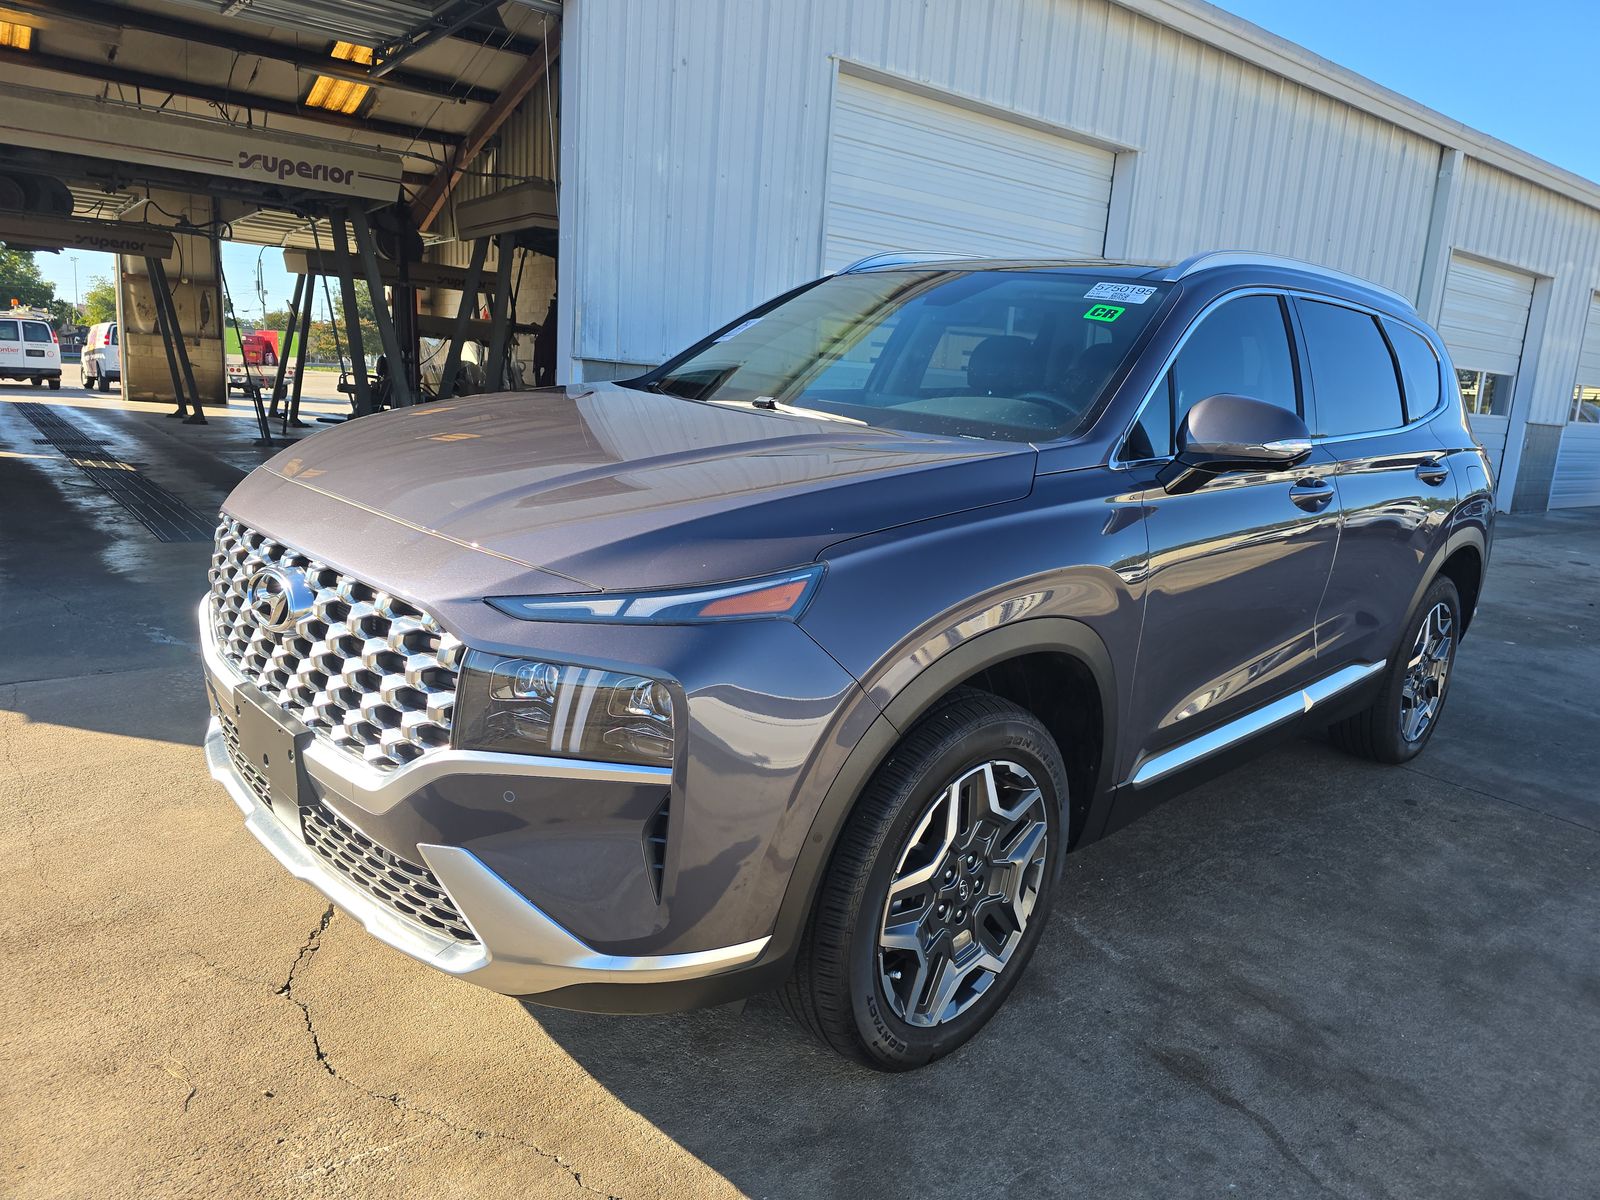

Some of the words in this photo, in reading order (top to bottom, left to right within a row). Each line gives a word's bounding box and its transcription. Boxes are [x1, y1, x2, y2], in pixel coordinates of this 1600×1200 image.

[1094, 283, 1154, 296] 5750195
[1089, 307, 1119, 319] CR
[866, 995, 906, 1053] CONTACT
